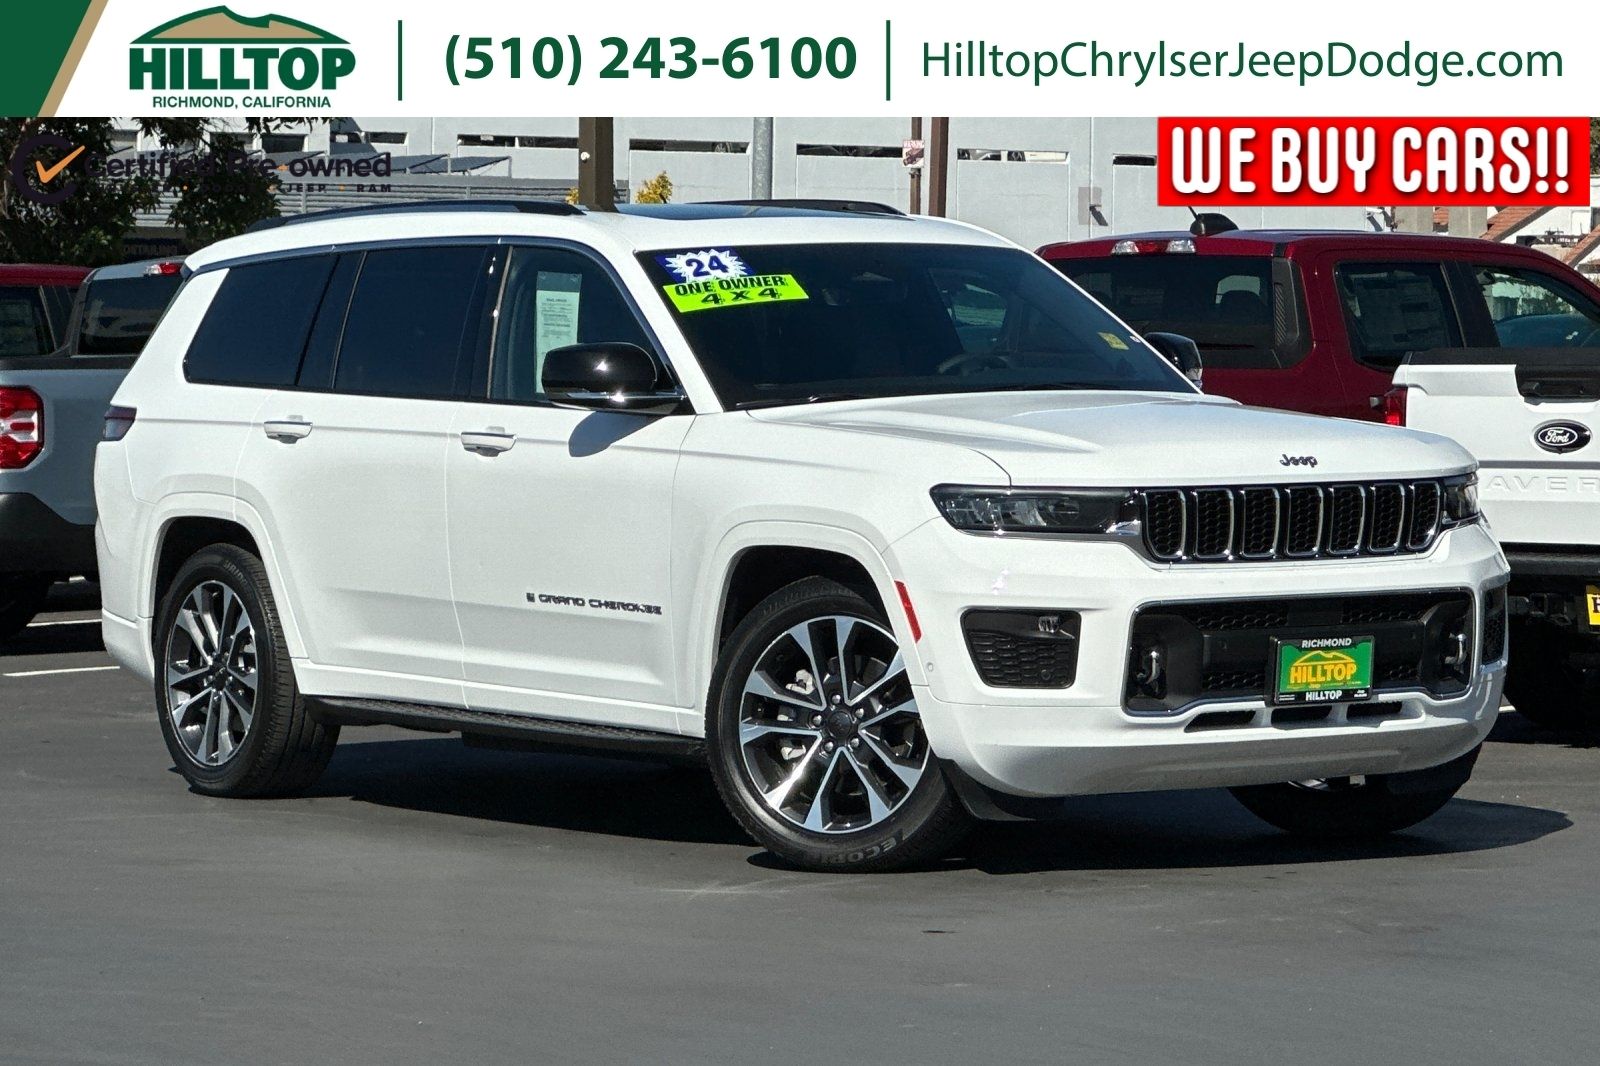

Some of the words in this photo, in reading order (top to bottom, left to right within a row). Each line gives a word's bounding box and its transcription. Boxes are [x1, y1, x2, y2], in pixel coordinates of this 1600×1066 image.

[685, 255, 731, 278] 24
[675, 281, 716, 297] ONE
[718, 275, 787, 291] OWNER
[1545, 429, 1570, 443] Ford
[1280, 453, 1318, 468] Jeep
[538, 593, 586, 607] GRAND
[588, 598, 662, 615] CHEROKEE
[1301, 637, 1352, 649] RICHMOND
[1289, 663, 1357, 684] HILLTOP
[1305, 689, 1343, 701] HILLTOP
